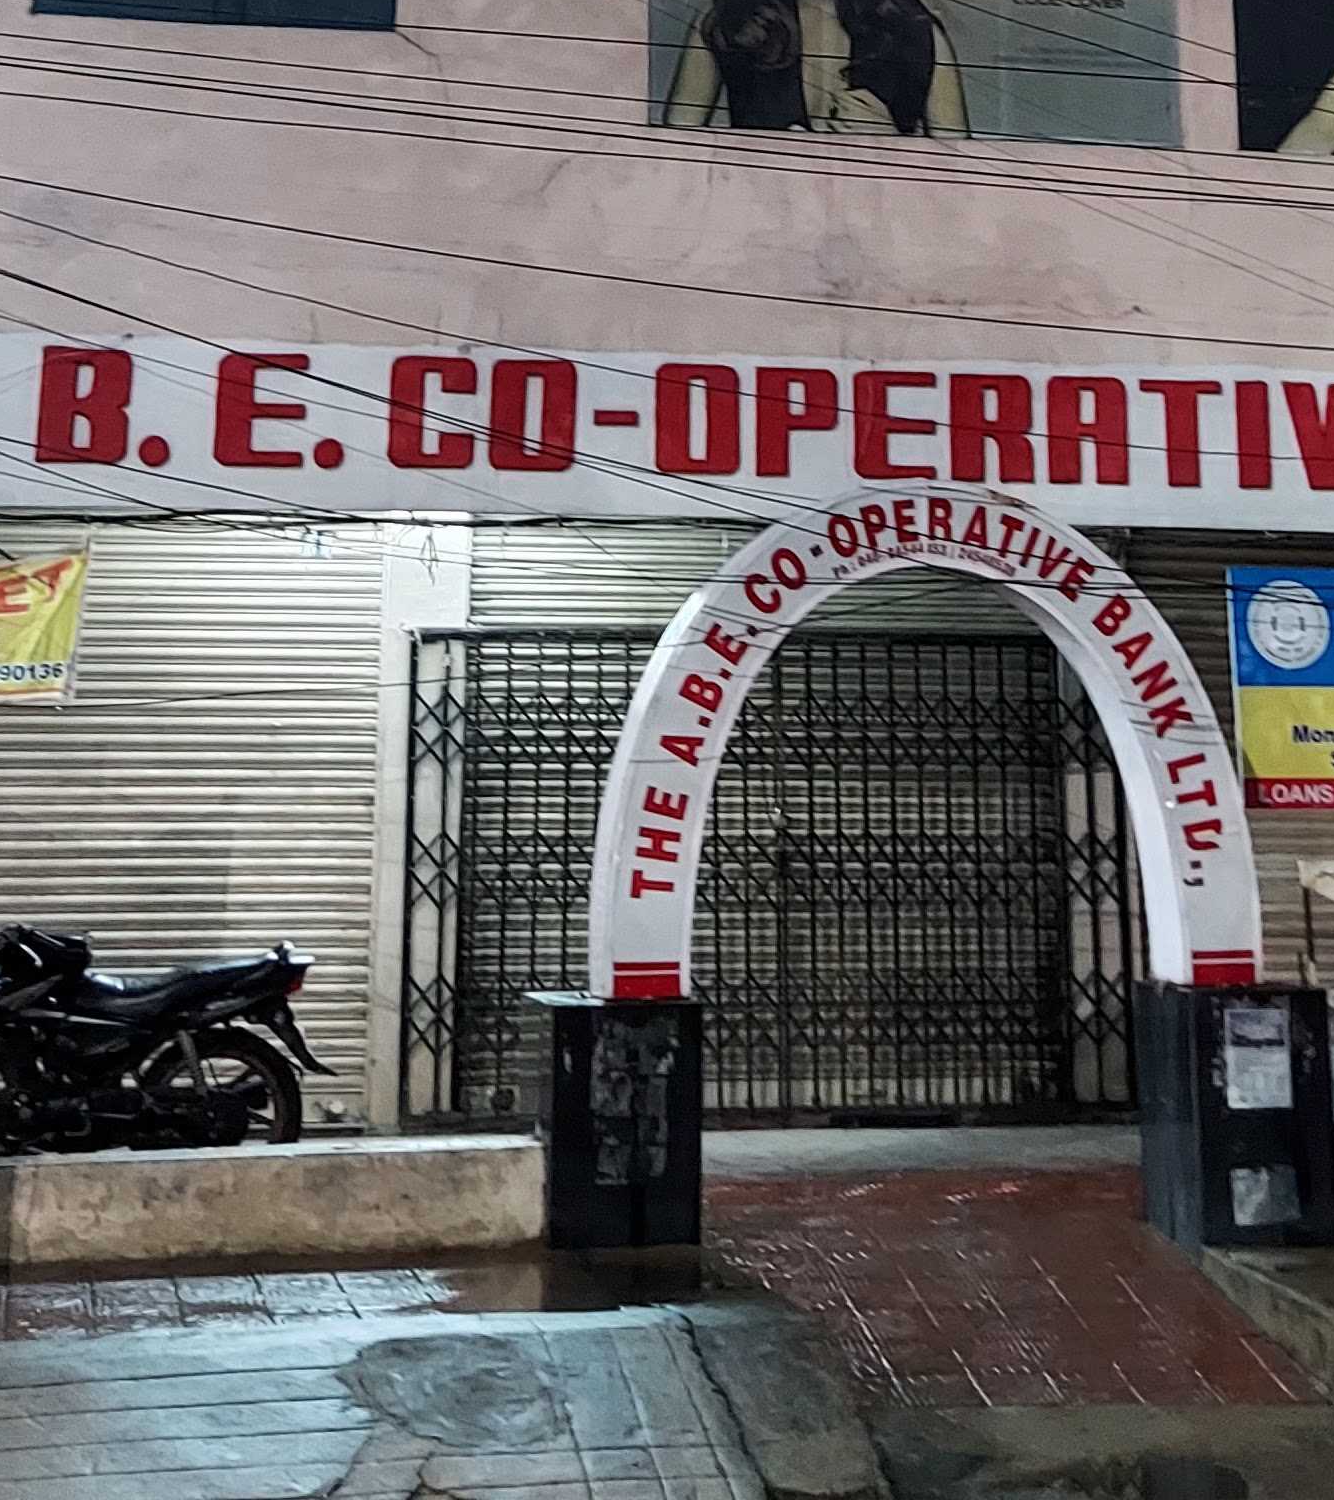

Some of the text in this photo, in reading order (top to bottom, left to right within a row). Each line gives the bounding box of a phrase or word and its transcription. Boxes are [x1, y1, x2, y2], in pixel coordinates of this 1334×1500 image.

[628, 785, 689, 898] THE
[1092, 593, 1195, 739] BANK
[1261, 784, 1334, 805] LOANS
